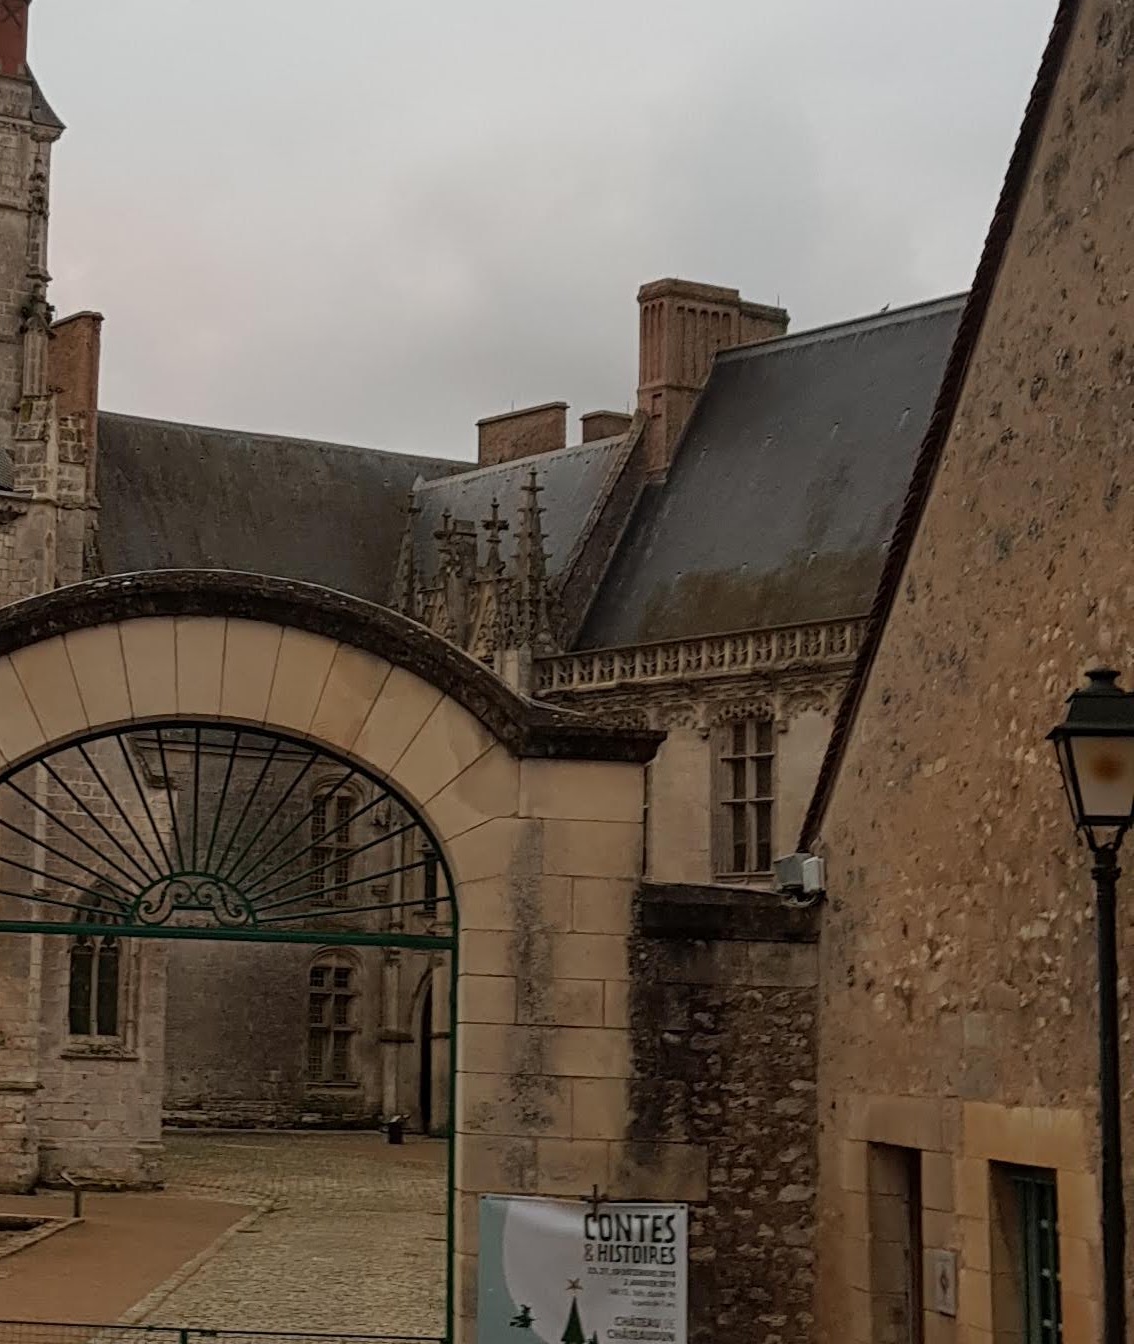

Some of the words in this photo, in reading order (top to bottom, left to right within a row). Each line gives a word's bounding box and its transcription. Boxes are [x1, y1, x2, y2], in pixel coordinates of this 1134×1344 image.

[584, 1213, 676, 1243] CONTES
[584, 1243, 594, 1263] &
[597, 1244, 676, 1265] HISTOIRES
